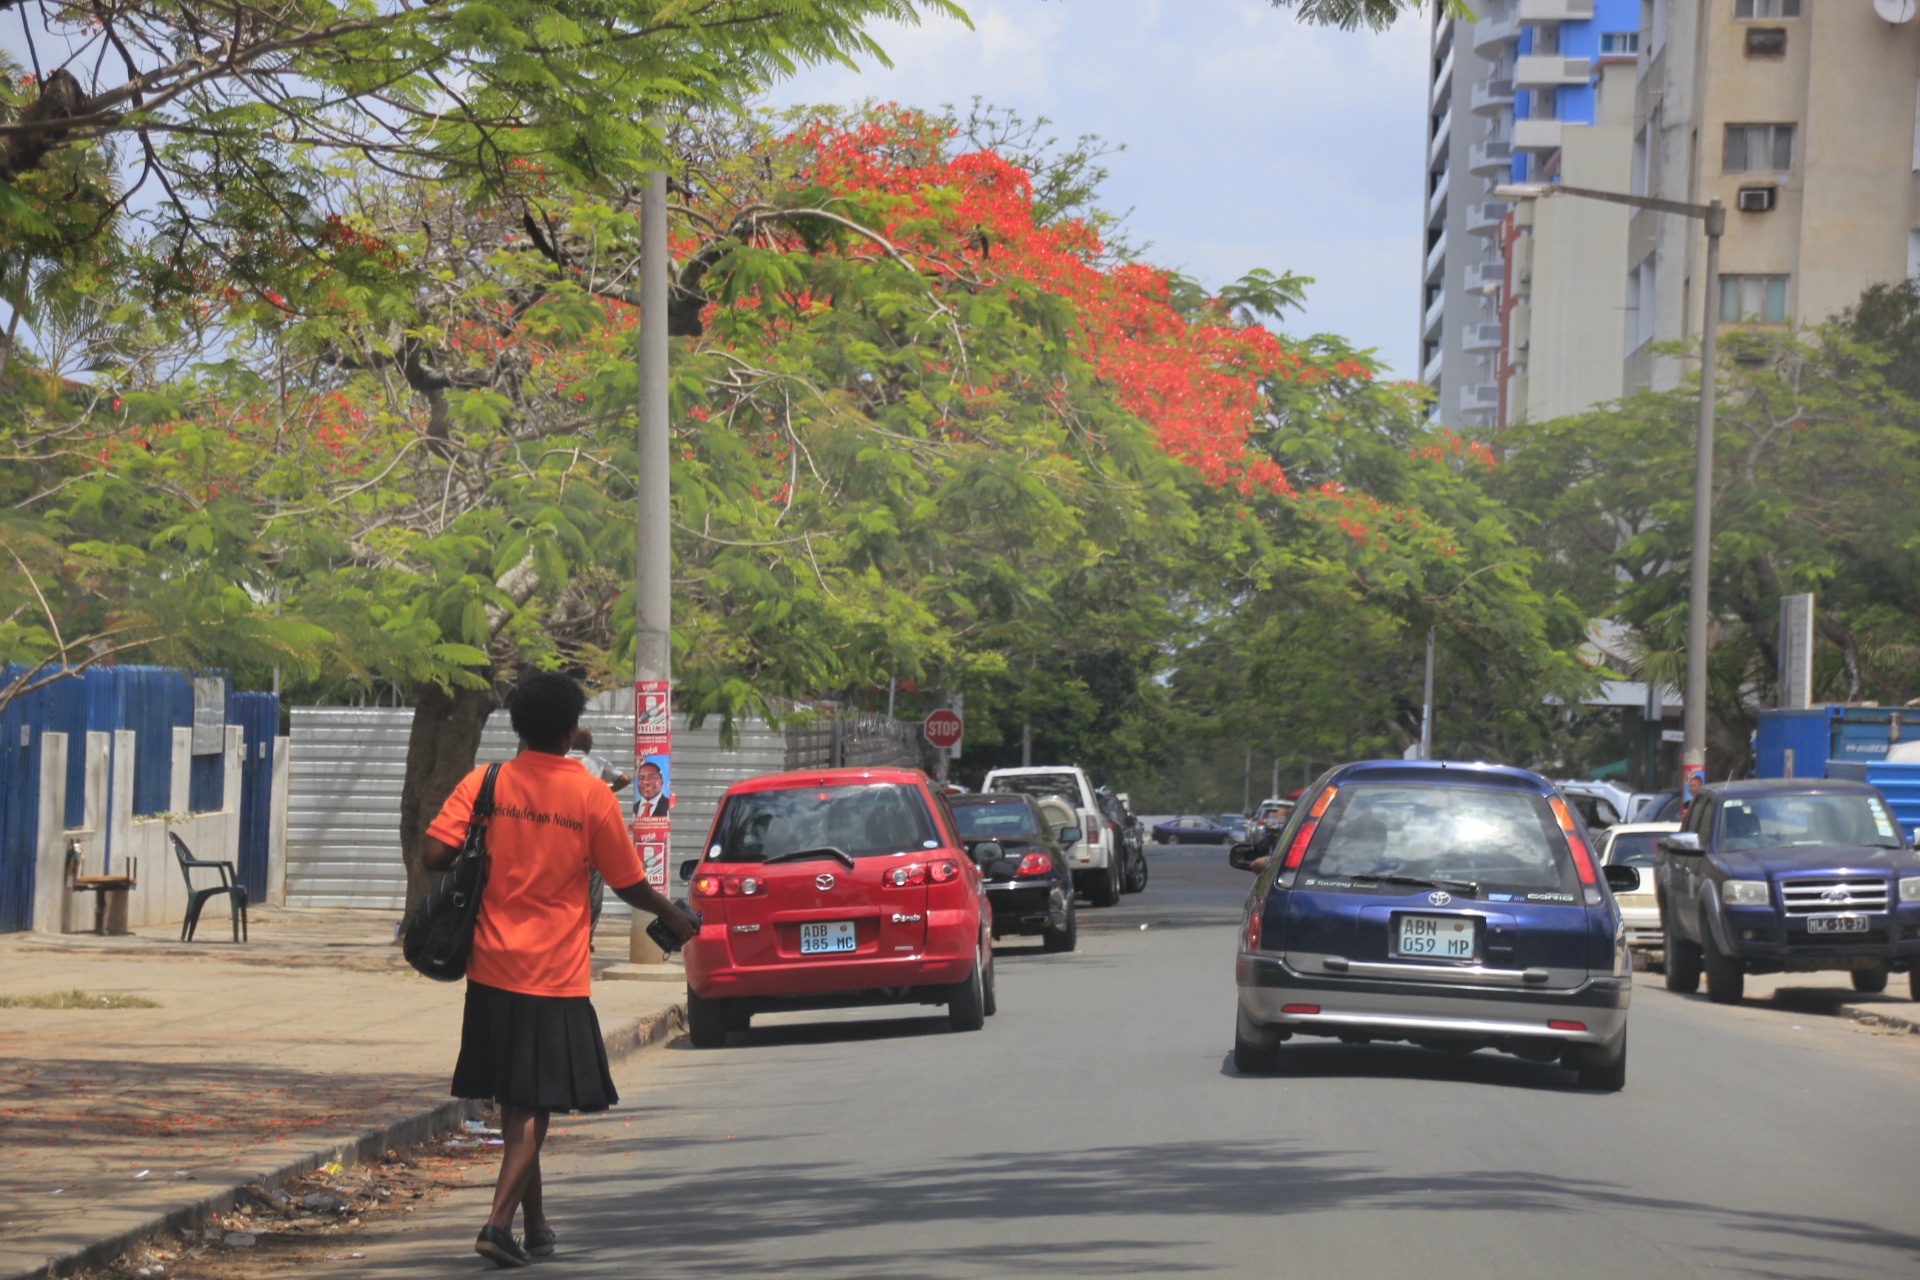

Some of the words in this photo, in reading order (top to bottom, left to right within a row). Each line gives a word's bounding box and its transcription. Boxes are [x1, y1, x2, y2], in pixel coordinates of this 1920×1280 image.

[642, 682, 658, 691] Vota
[928, 720, 959, 736] STOP
[640, 746, 658, 756] Vota
[494, 803, 536, 822] elicidades
[537, 812, 550, 824] aos
[554, 812, 583, 831] Noivos
[640, 832, 656, 842] Vota
[803, 925, 828, 938] ADB
[1404, 919, 1436, 936] ABN
[804, 938, 828, 951] 185
[837, 936, 853, 950] MC
[1403, 937, 1435, 953] 059
[1447, 940, 1468, 955] MP
